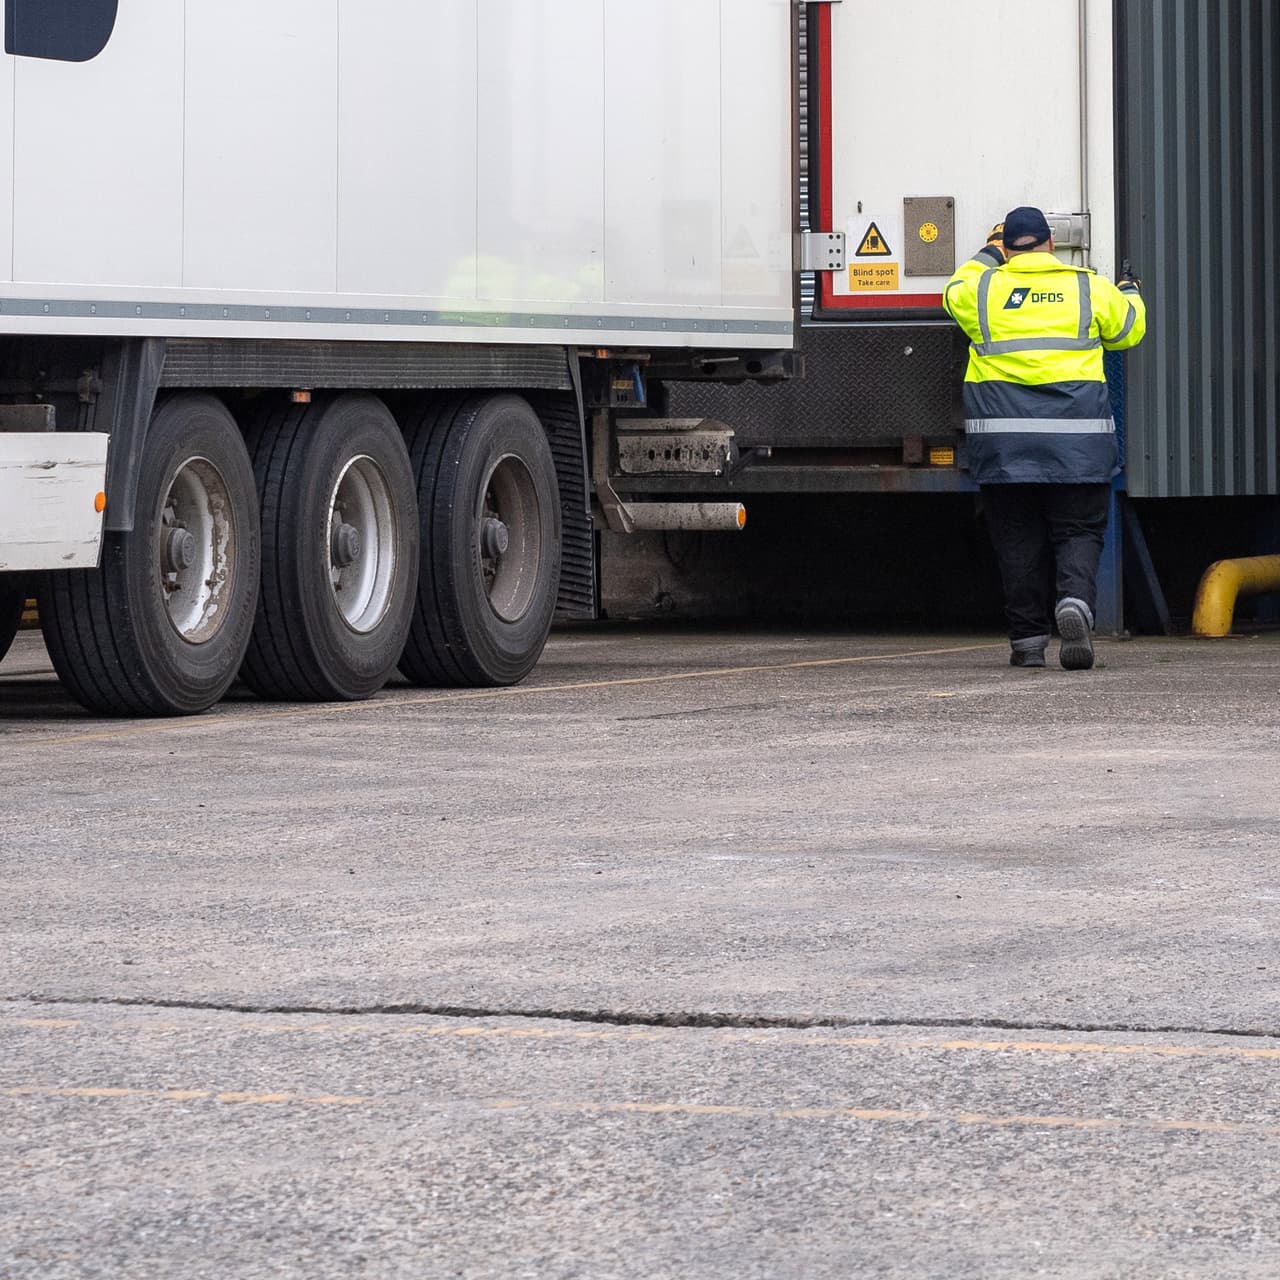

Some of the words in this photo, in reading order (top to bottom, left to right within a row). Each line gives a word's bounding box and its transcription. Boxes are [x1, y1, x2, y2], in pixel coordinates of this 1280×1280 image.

[853, 268, 873, 277] Blind
[876, 268, 895, 278] spot
[857, 279, 873, 287] Take
[1031, 292, 1065, 303] DFDS
